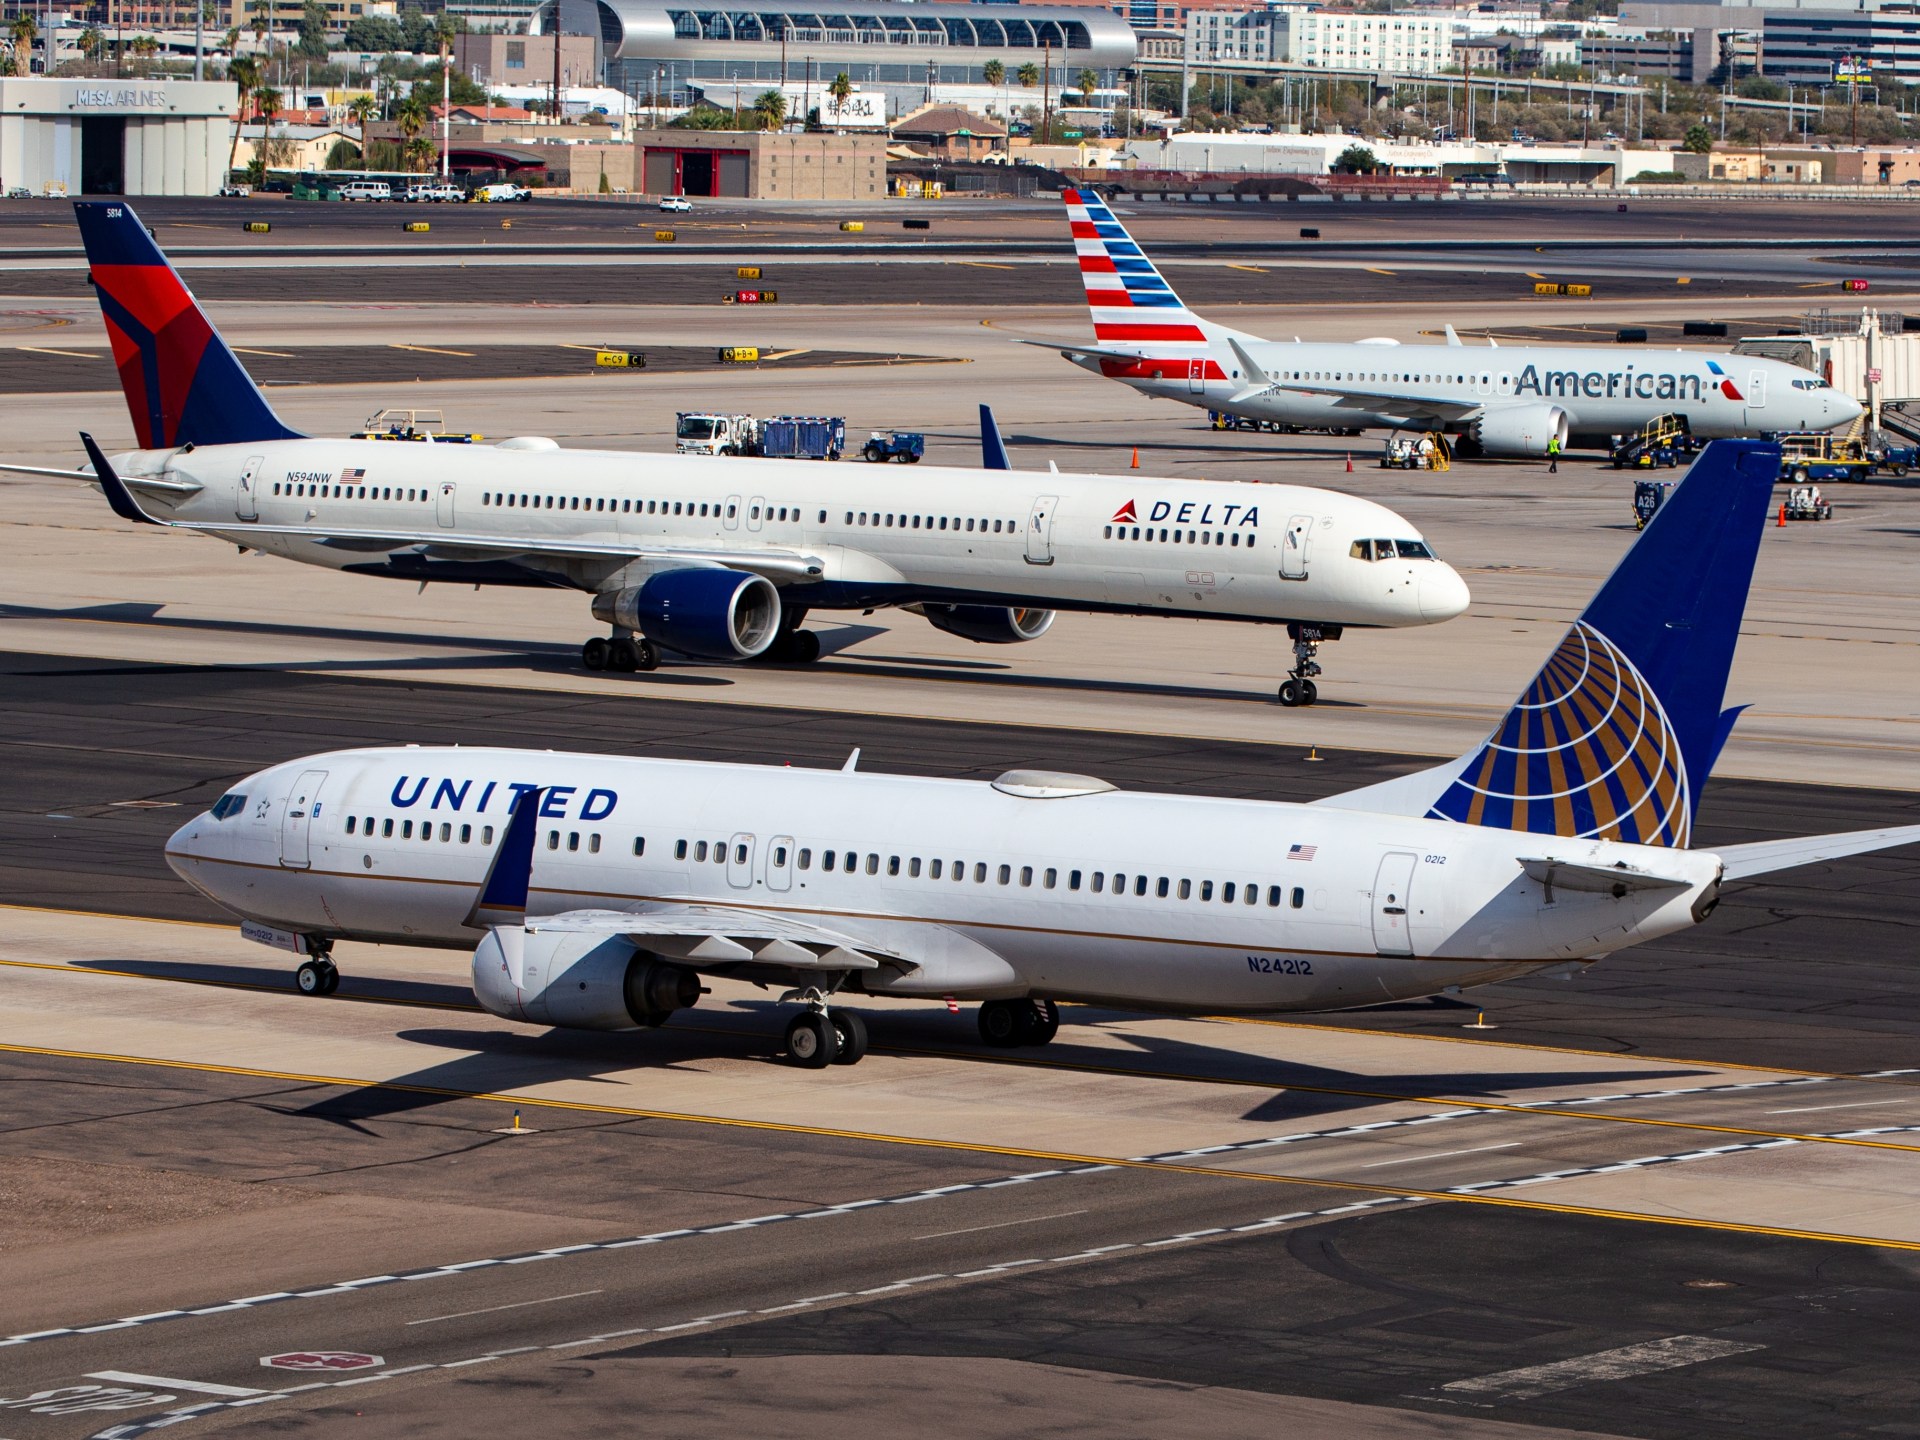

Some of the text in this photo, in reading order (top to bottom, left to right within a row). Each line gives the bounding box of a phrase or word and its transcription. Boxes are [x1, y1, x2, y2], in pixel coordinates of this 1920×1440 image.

[77, 90, 165, 107] MESA AIRLINES
[107, 209, 122, 218] 5814
[611, 355, 623, 364] C9
[1514, 364, 1700, 400] American
[287, 472, 332, 484] N594NW
[1638, 496, 1655, 508] A26
[1150, 501, 1258, 527] DELTA
[1303, 628, 1321, 639] 5814
[390, 776, 618, 821] UNITED
[1425, 855, 1446, 865] 0212
[1247, 956, 1314, 975] N24212
